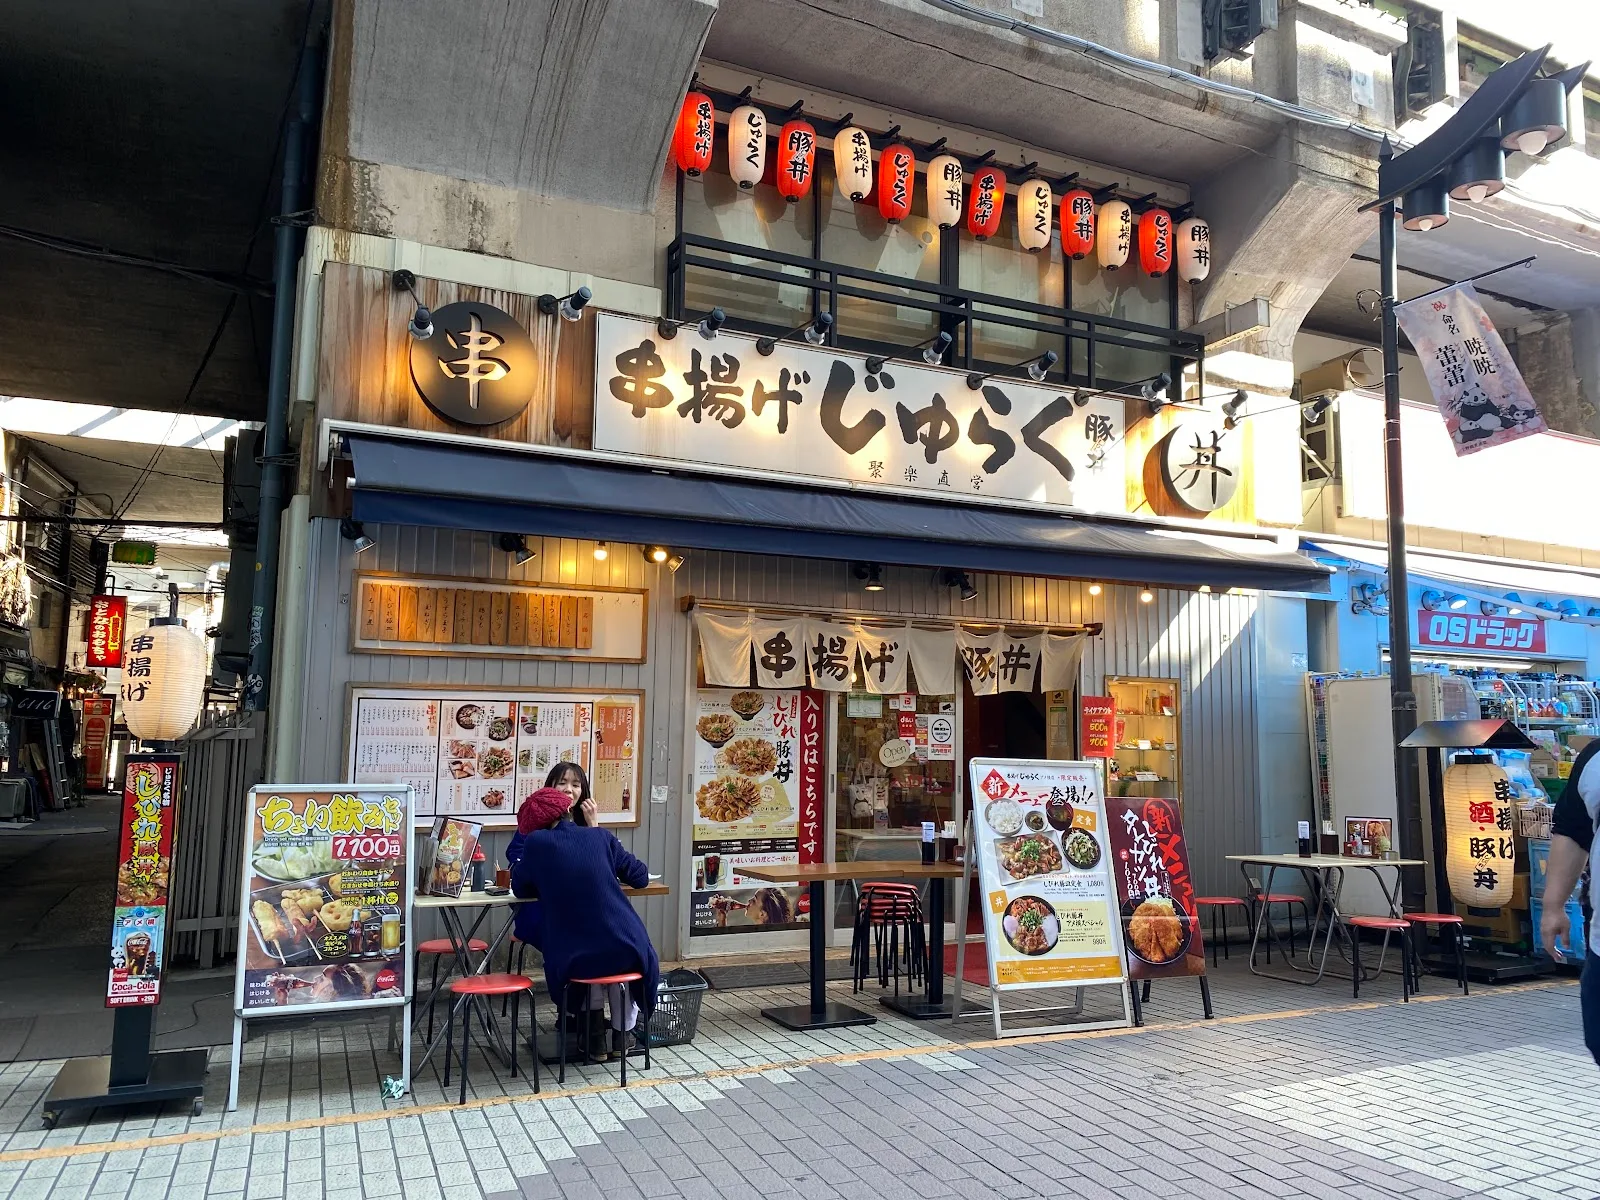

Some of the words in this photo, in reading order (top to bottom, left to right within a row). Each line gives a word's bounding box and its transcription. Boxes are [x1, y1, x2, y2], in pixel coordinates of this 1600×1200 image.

[695, 101, 712, 157] 串揚げ
[746, 112, 764, 169] じゅらく
[786, 131, 814, 183] 豚丼
[851, 131, 870, 178] 串揚げ
[892, 152, 911, 208] じゅらく
[943, 163, 963, 211] 豚丼
[973, 174, 995, 226] 串揚げ
[1034, 186, 1050, 236] じゅらく
[1072, 197, 1094, 241] 豚丼
[1118, 208, 1131, 256] 串揚げ
[1154, 214, 1170, 262] じゅらく
[1191, 225, 1210, 267] 豚丼
[1441, 314, 1460, 336] 命名
[438, 311, 511, 410] 串
[608, 338, 811, 434] 串揚げ
[820, 358, 1076, 483] じゅらく
[1084, 413, 1116, 474] 豚丼
[1179, 429, 1233, 505] 丼
[867, 459, 984, 492] 聚楽直営
[92, 600, 110, 662] おとなのおもちゃ
[1428, 614, 1538, 649] OSドラッグ
[127, 634, 154, 702] 串揚げ
[760, 631, 900, 683] 串揚げ
[961, 643, 1032, 687] 豚丼
[1083, 706, 1113, 714] テイクアウト
[773, 695, 798, 784] しびれ豚丼
[883, 745, 907, 759] Open
[802, 695, 820, 857] 入り口はこちらです
[987, 776, 1004, 796] 新
[136, 774, 161, 876] しびれ豚丼
[257, 793, 386, 835] ちょい飲み
[384, 795, 403, 834] セット
[1075, 813, 1093, 828] 定食
[1148, 804, 1173, 833] 新
[1493, 778, 1515, 860] 串揚げ
[335, 838, 400, 857] 1,100円
[1142, 820, 1167, 873] しびれ
[995, 896, 1004, 908] 丼
[112, 982, 156, 991] Coca-Cola
